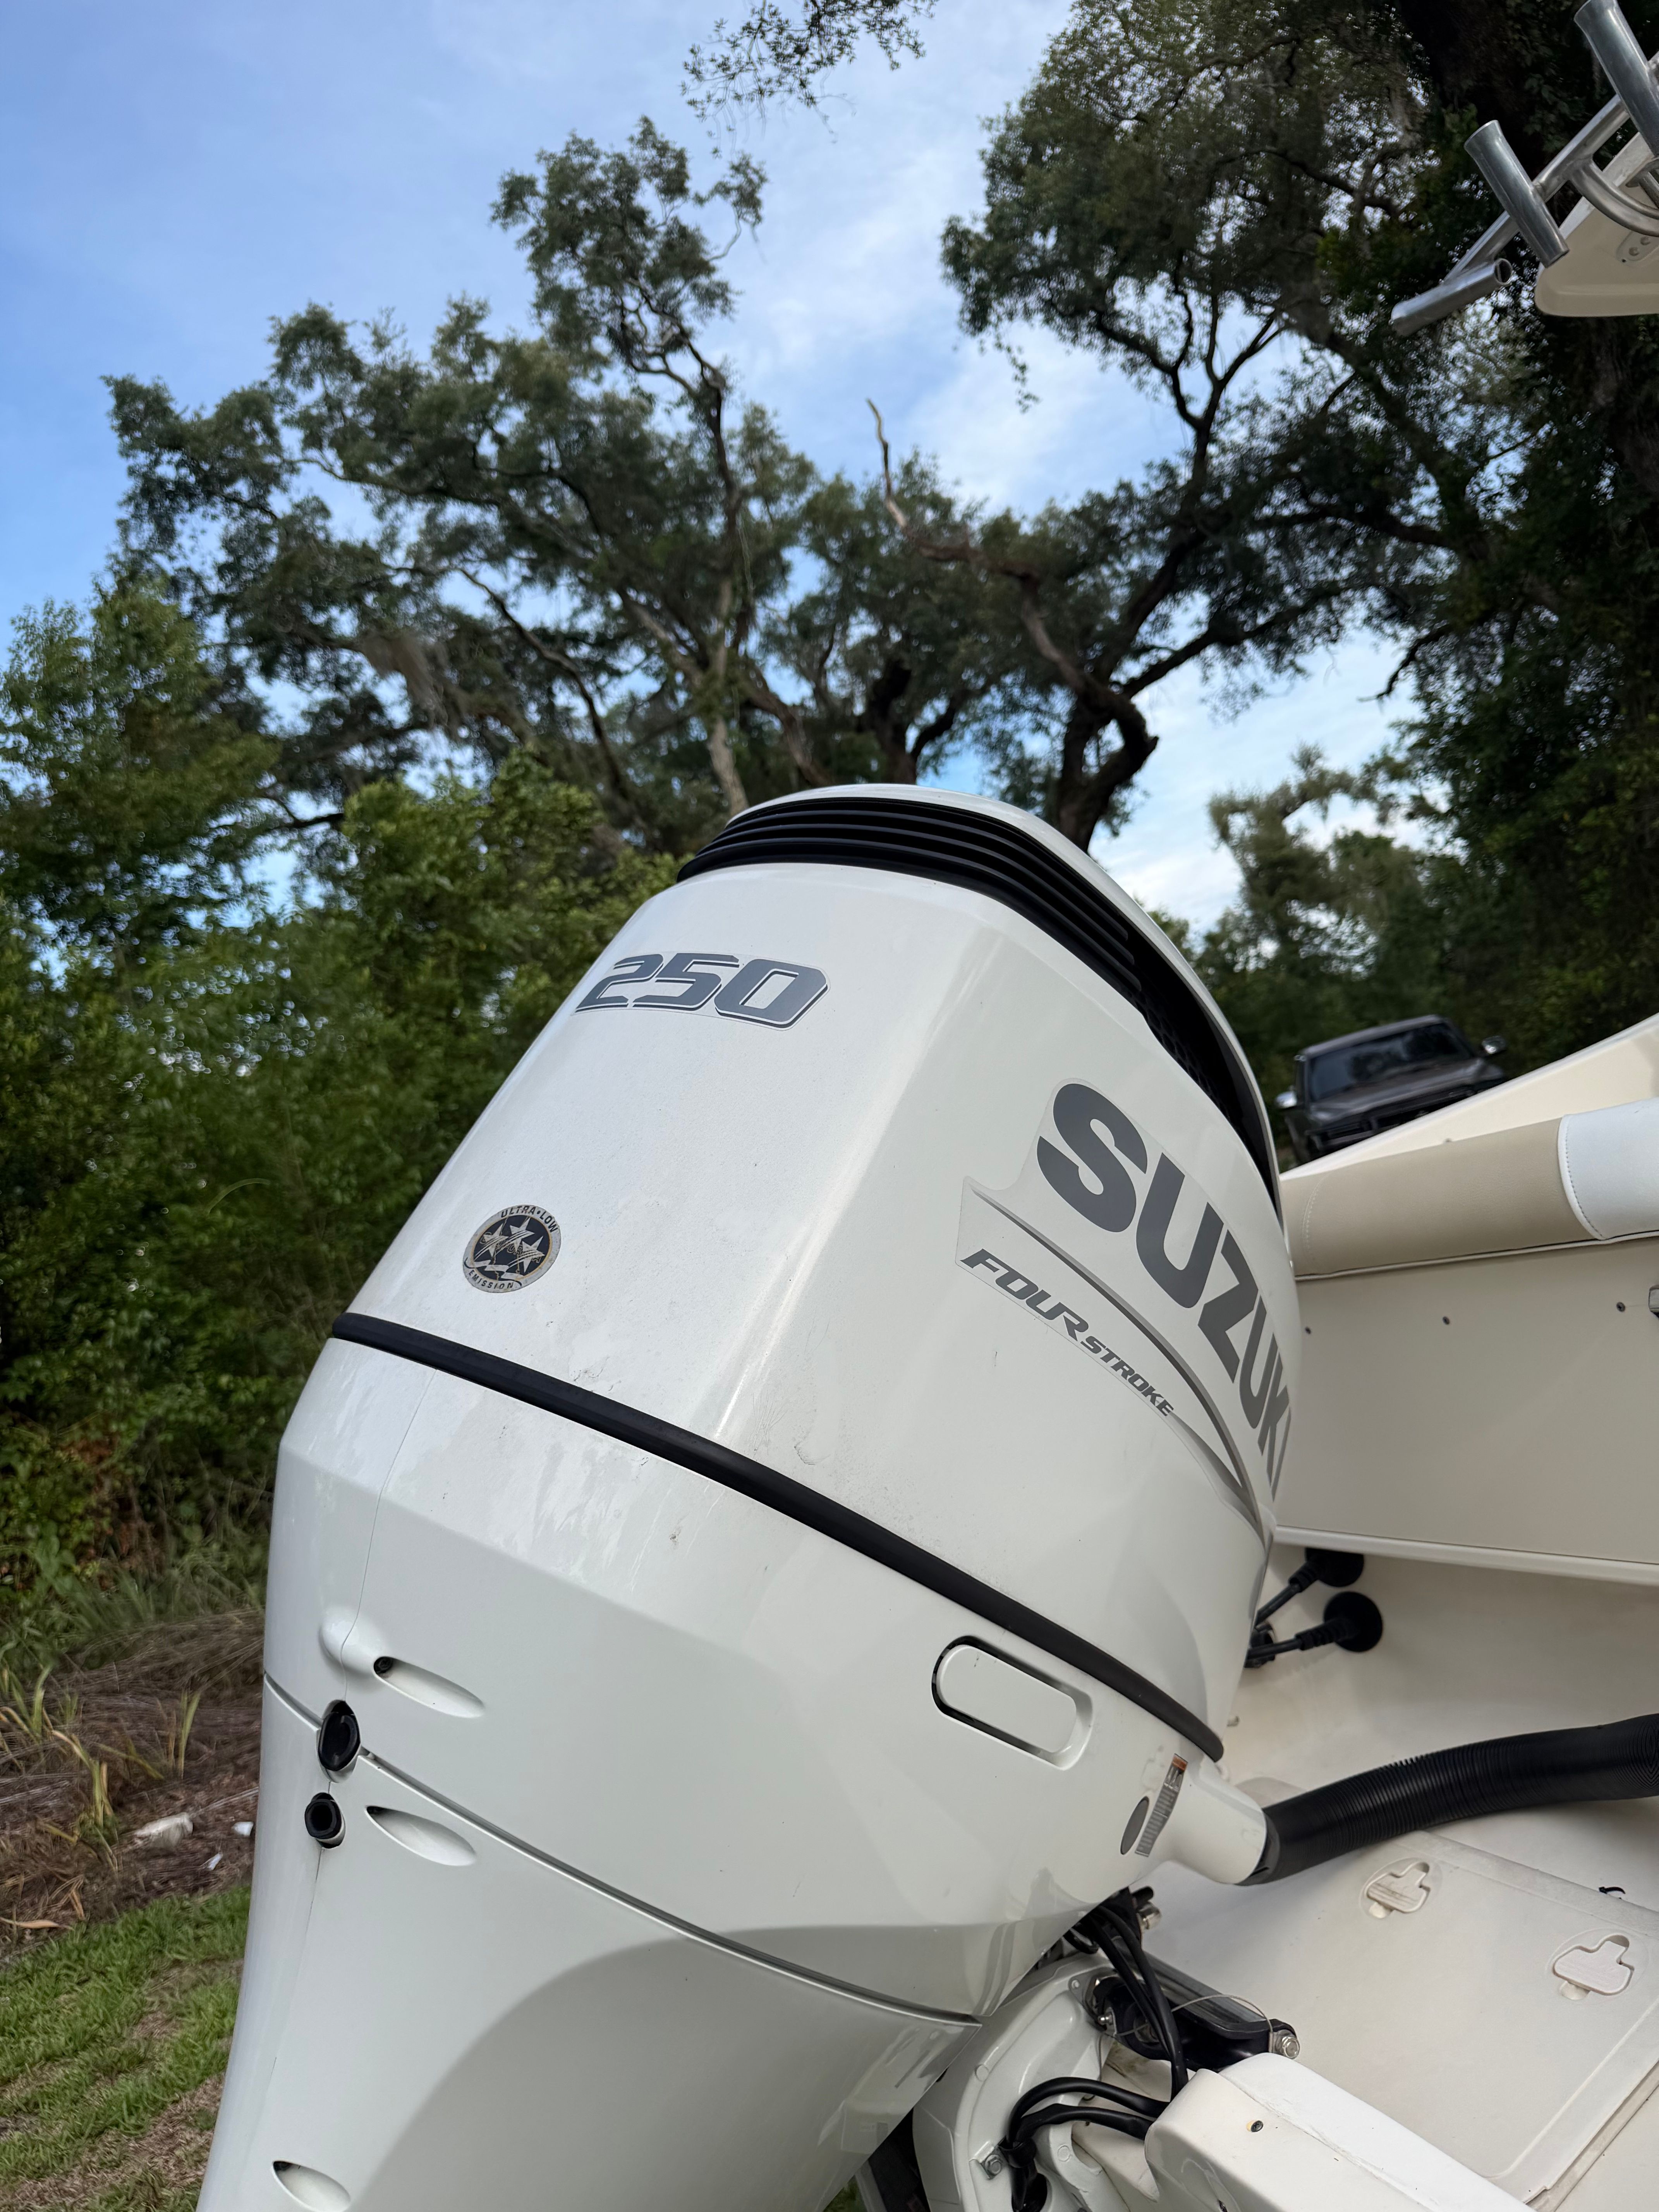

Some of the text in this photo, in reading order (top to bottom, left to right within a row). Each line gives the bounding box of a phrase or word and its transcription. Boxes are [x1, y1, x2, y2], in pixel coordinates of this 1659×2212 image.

[575, 953, 828, 1029] 250
[469, 1269, 514, 1289] EMISSION
[960, 1248, 1174, 1416] FOUR STROKE
[1036, 1083, 1291, 1502] SUZUKI
